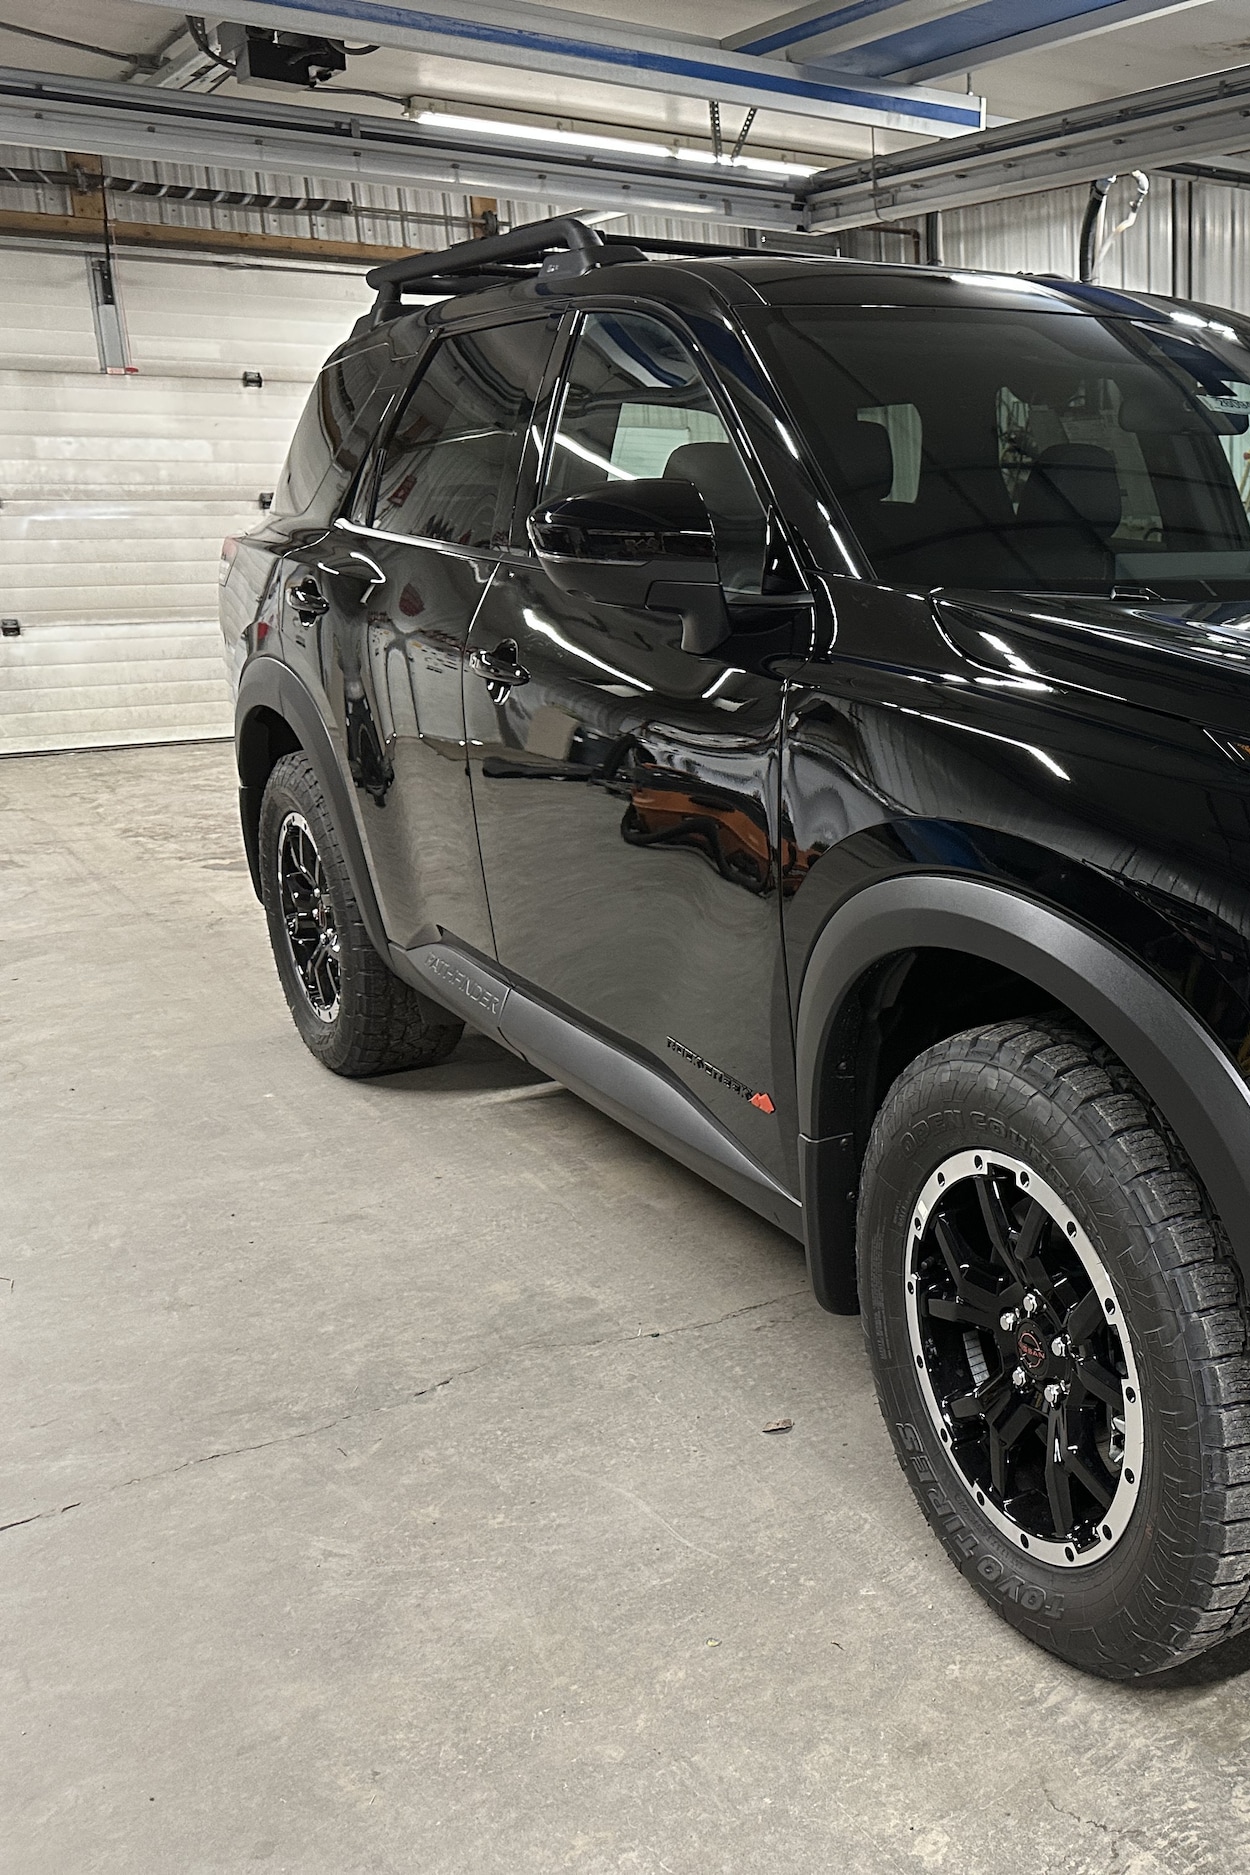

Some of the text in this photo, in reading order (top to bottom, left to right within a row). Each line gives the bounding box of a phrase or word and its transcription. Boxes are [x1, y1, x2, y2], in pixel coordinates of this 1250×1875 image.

[424, 951, 500, 1015] PATHFINDER
[900, 1109, 966, 1160] OPEN
[895, 1421, 981, 1560] TIRES
[976, 1553, 1066, 1620] TOYO
